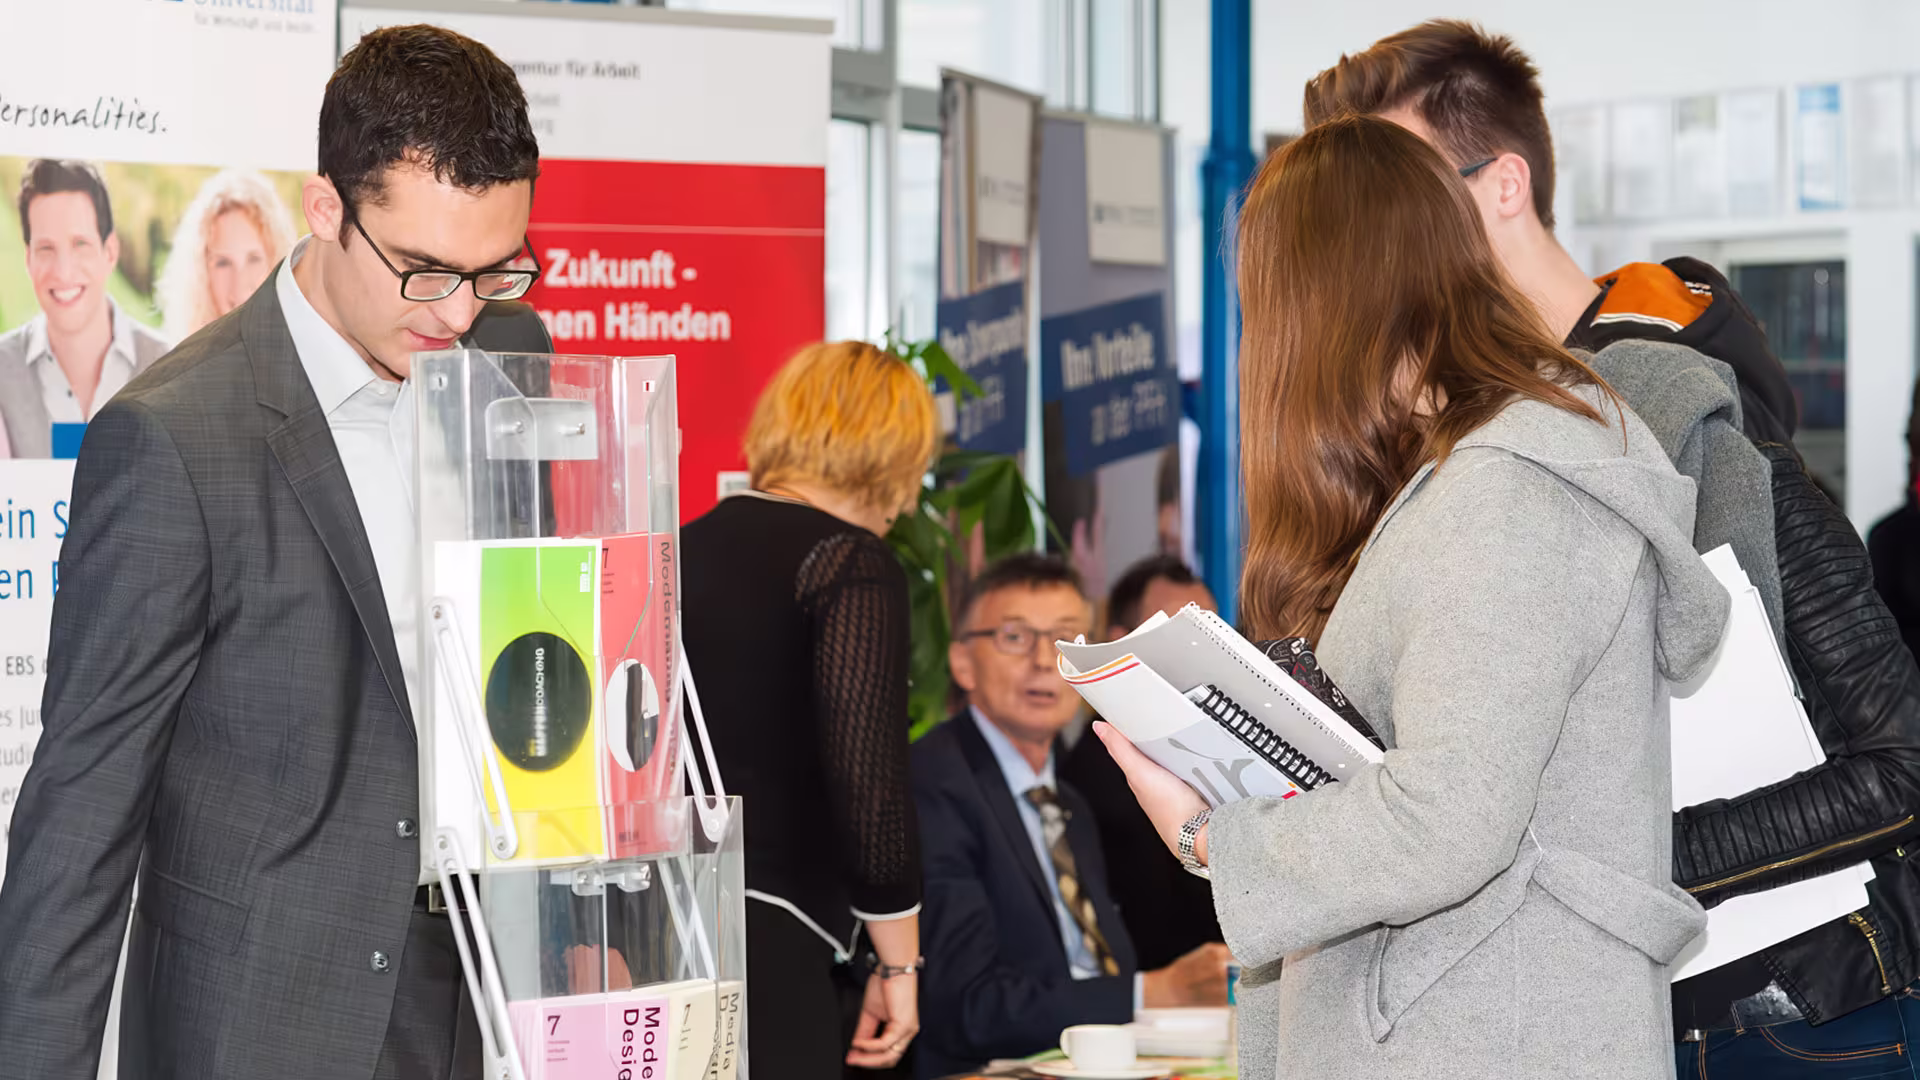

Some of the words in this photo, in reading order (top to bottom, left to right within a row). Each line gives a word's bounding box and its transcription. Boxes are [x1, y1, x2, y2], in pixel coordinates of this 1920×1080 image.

[544, 248, 676, 289] Zukunft
[605, 302, 731, 340] Händen
[6, 655, 35, 676] EBS
[547, 1014, 561, 1036] 7
[641, 1007, 661, 1079] Mode
